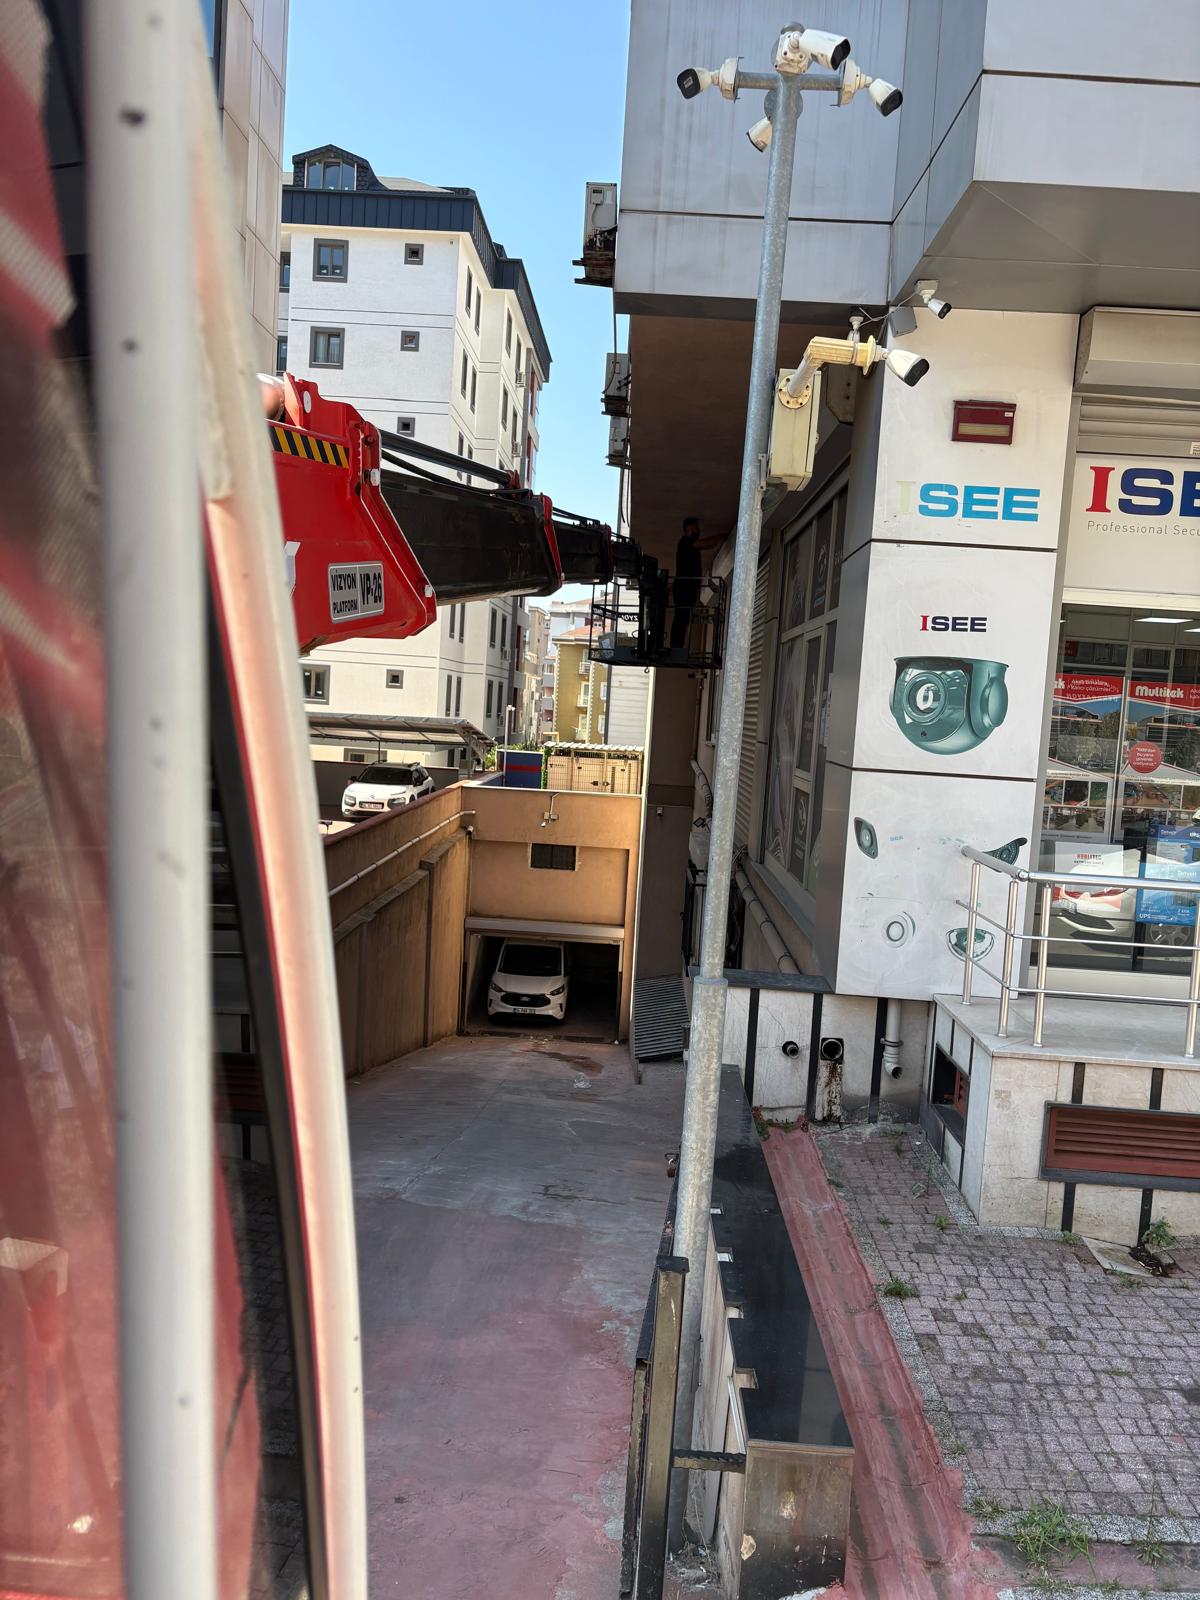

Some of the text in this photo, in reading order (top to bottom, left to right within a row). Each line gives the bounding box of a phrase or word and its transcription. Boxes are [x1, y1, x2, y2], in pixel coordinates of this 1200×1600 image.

[897, 480, 1041, 522] ISEE
[1087, 520, 1168, 535] Professional
[331, 570, 357, 591] VİZYON
[360, 573, 382, 605] VP-26
[333, 599, 358, 614] PLATFORM
[919, 615, 988, 633] ISEE
[1135, 685, 1184, 699] Multitek
